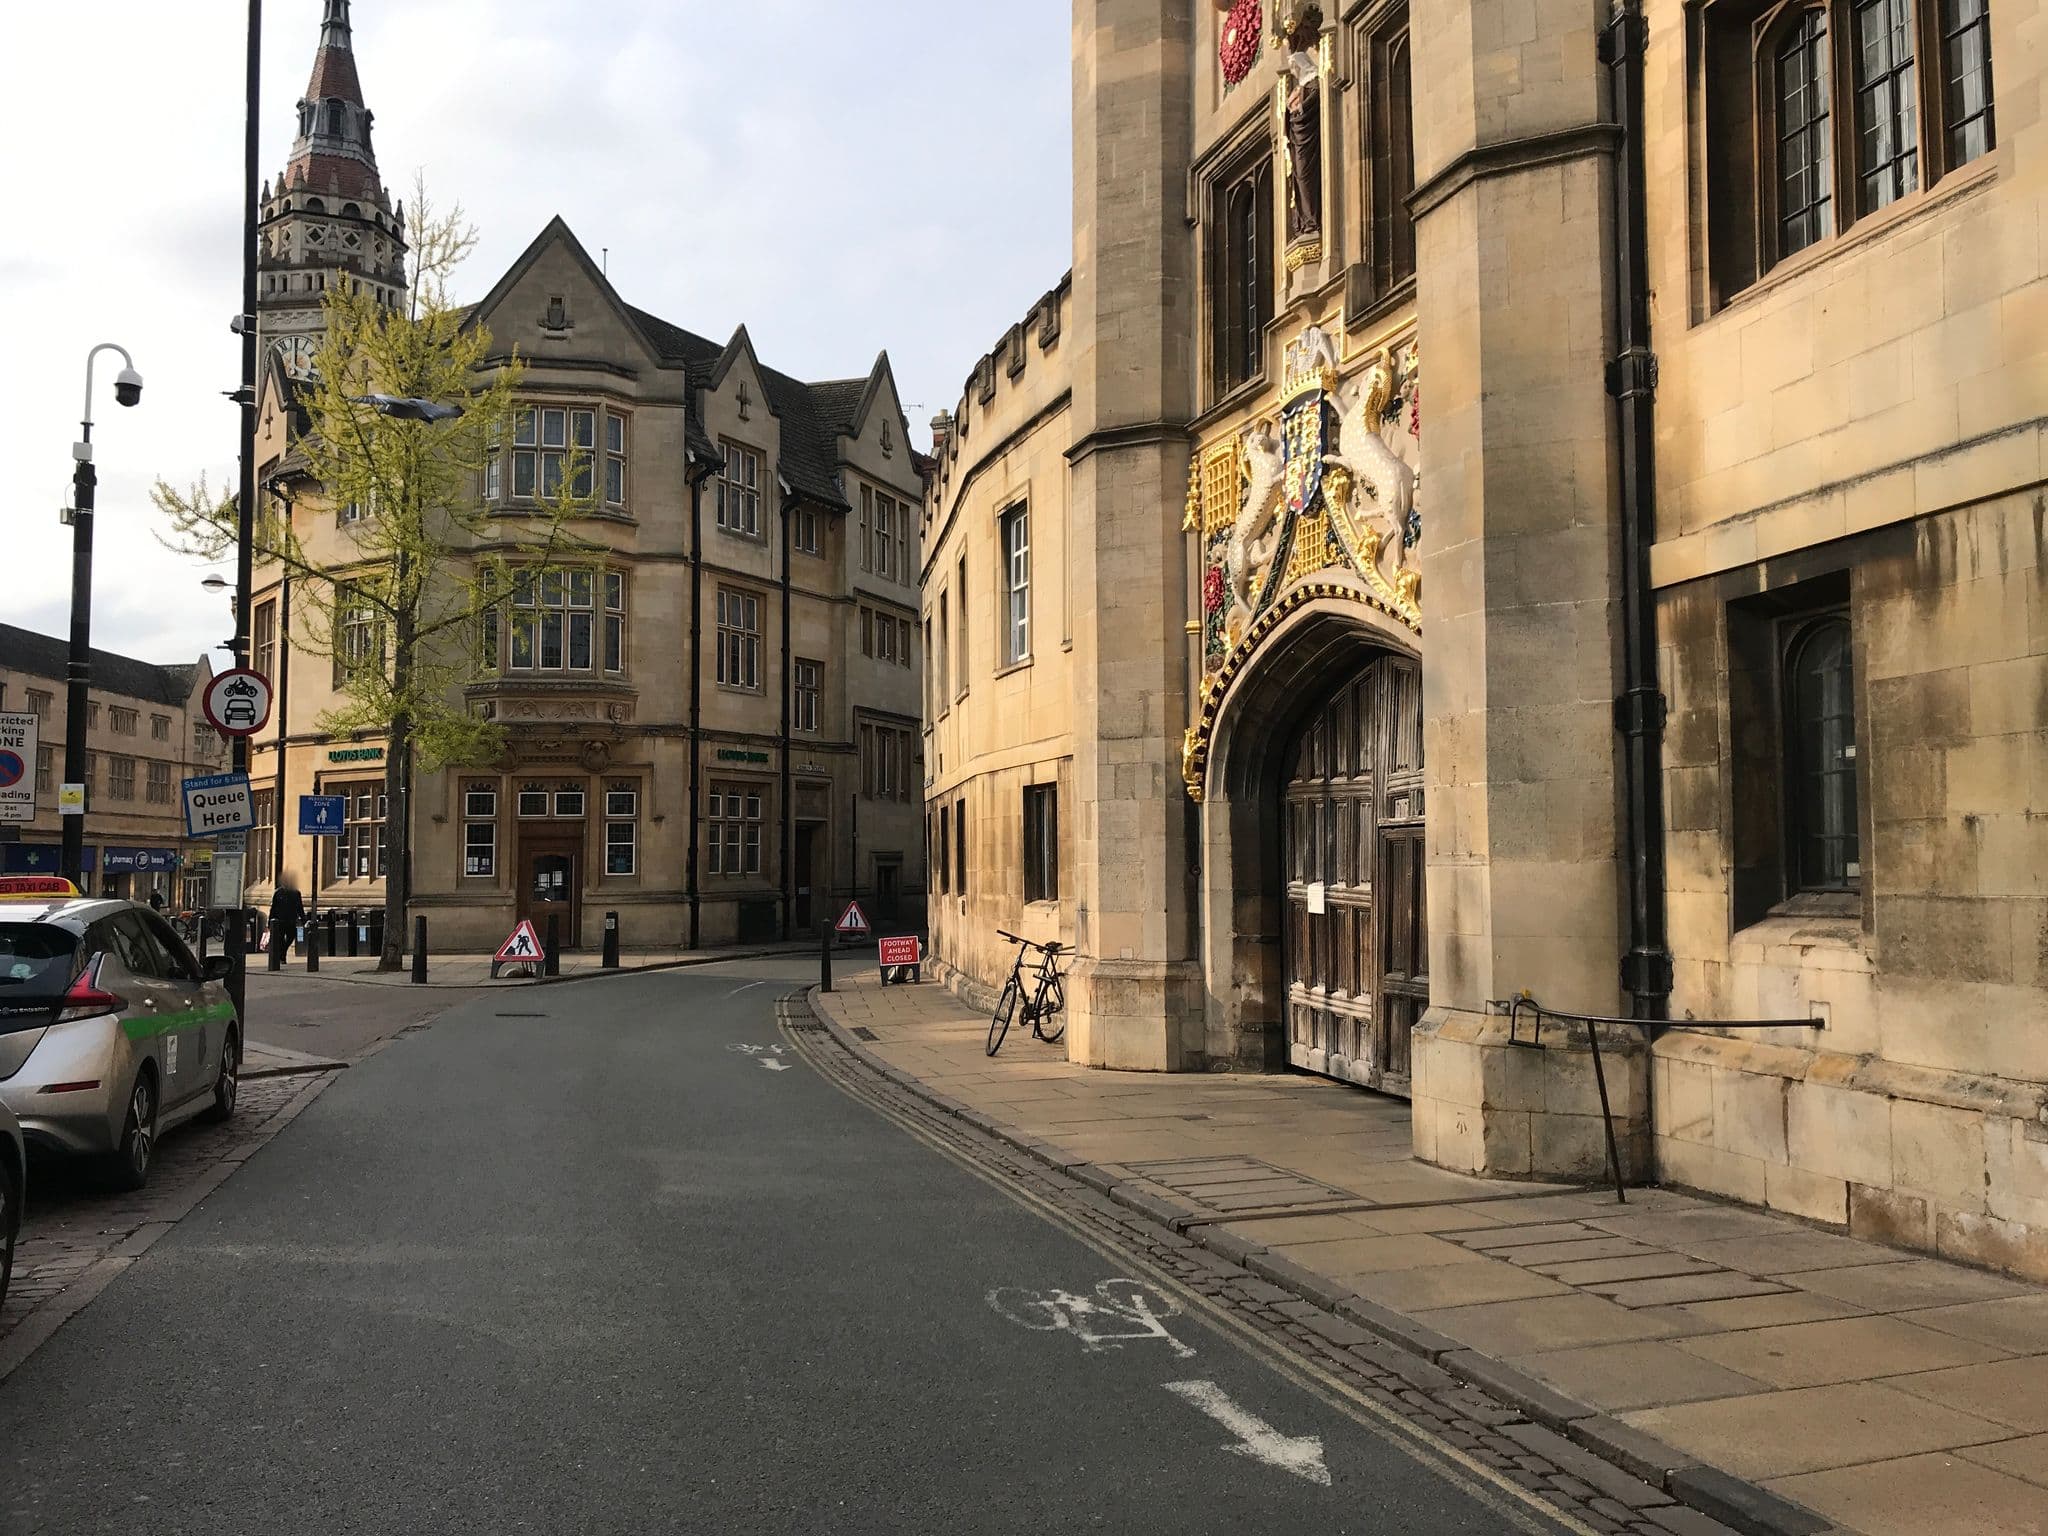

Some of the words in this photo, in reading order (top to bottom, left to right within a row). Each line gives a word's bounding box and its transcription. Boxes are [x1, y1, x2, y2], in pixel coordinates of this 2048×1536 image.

[0, 717, 33, 725] ricted
[0, 727, 25, 736] king
[0, 737, 24, 747] NE
[329, 749, 357, 762] LLOYDS
[358, 747, 382, 760] BANK
[184, 779, 208, 788] Stand
[210, 777, 222, 785] for
[193, 792, 245, 808] Queue
[203, 812, 241, 826] Here
[112, 856, 133, 864] pharmacy
[14, 882, 35, 891] TAXI
[39, 882, 60, 891] CAB
[883, 939, 914, 947] FOOTWAY
[886, 954, 913, 962] CLOSED
